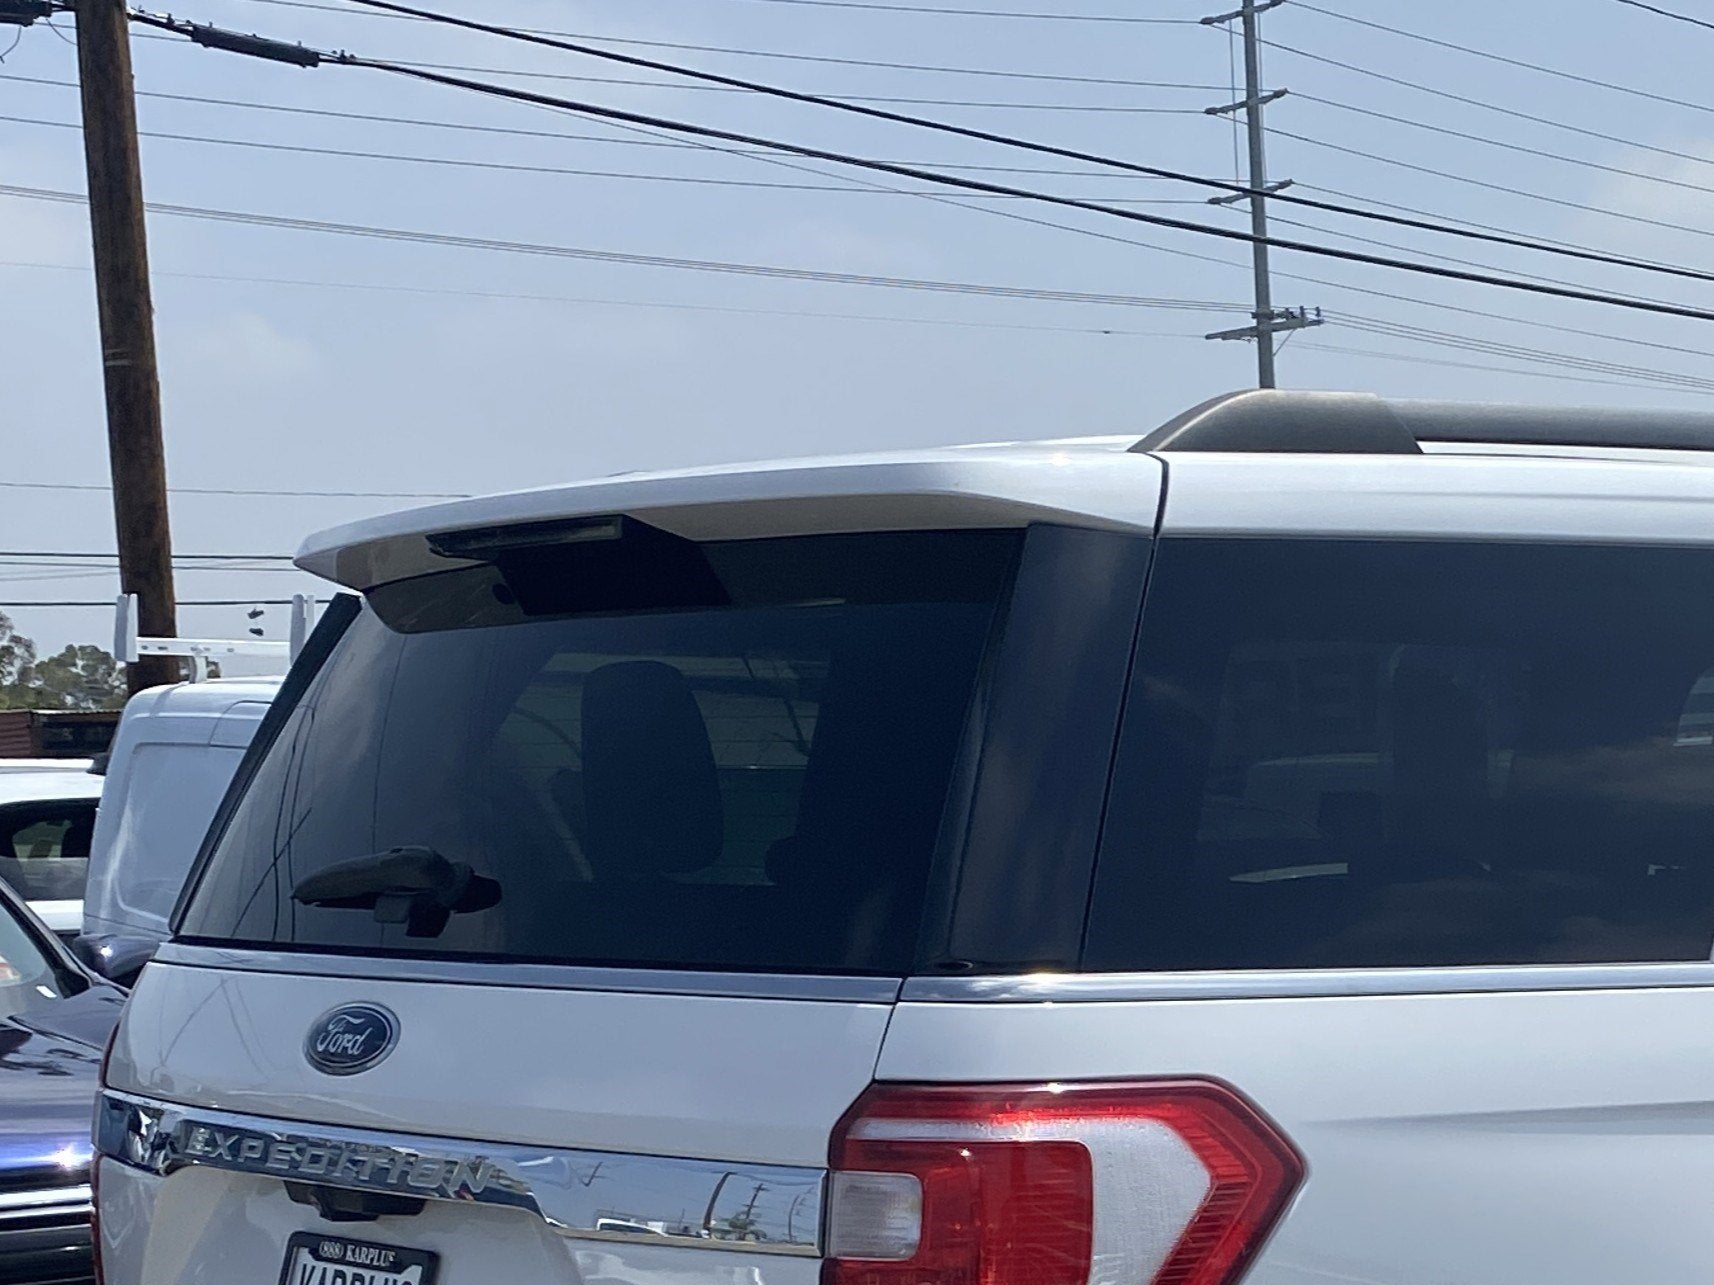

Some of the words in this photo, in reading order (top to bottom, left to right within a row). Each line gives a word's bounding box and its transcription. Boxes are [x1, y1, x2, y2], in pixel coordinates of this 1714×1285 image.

[316, 1014, 374, 1056] Ford
[184, 1126, 493, 1197] EXPEDITION
[345, 1244, 396, 1267] KARPLUS
